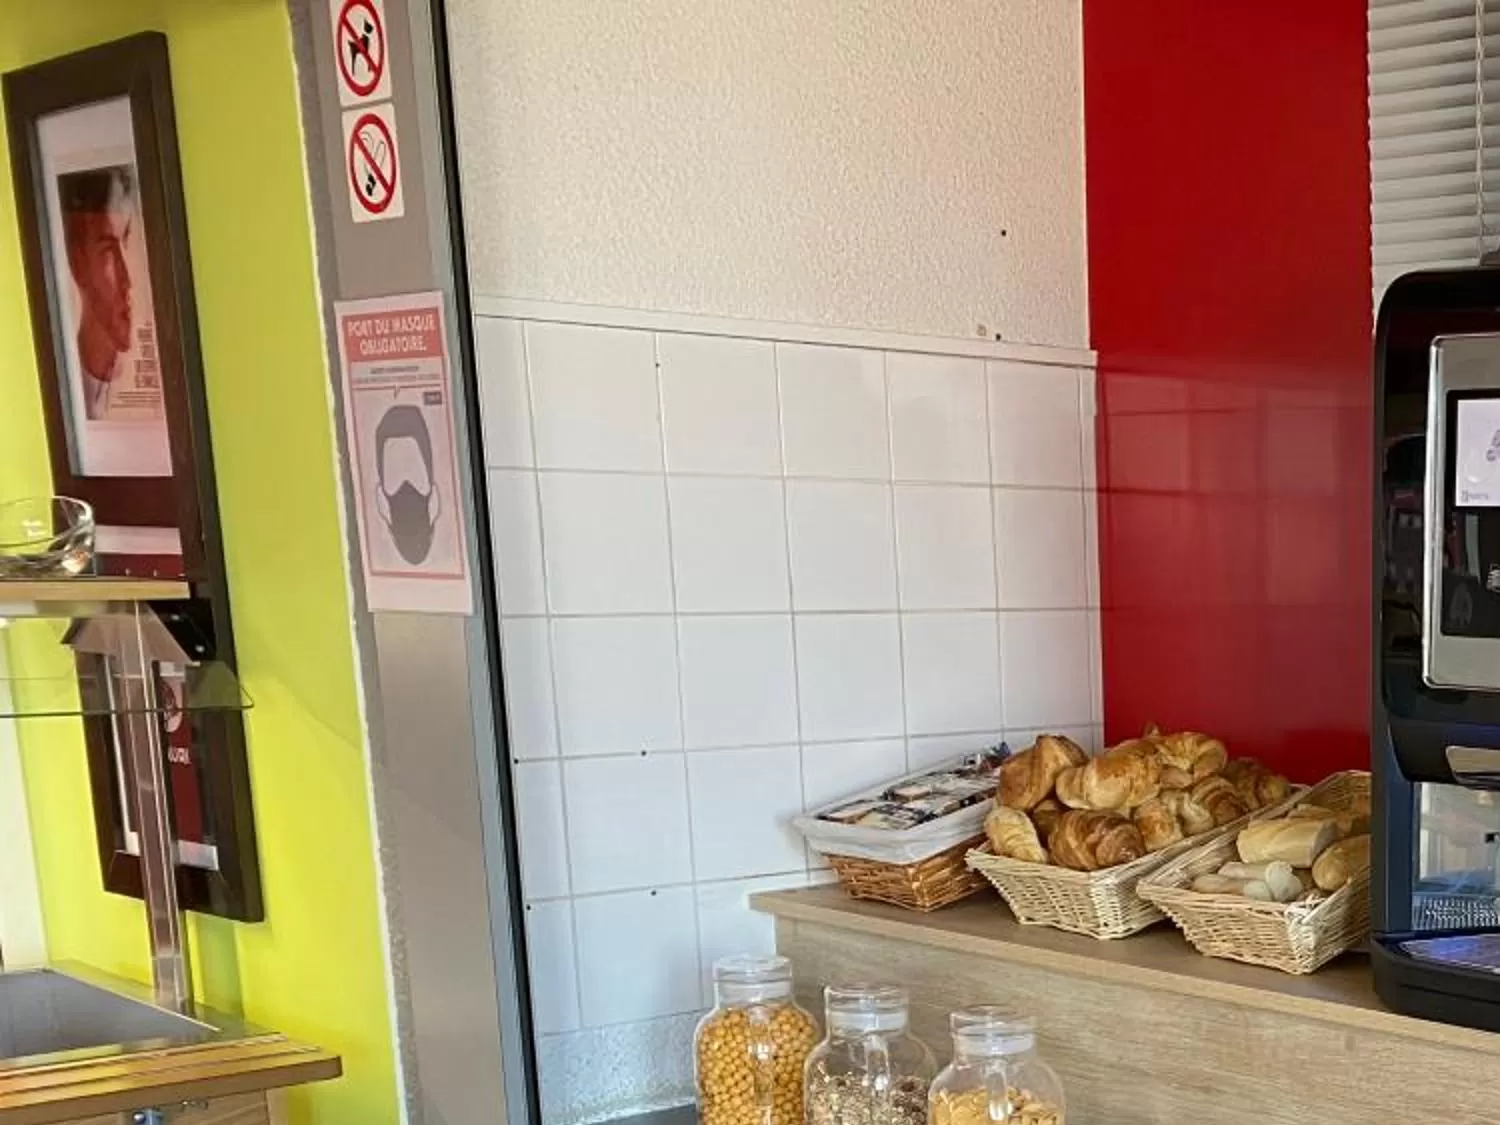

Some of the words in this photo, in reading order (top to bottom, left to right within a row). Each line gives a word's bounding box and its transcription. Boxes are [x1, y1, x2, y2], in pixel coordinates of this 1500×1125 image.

[347, 320, 373, 337] PORT
[375, 319, 389, 334] DU
[391, 314, 436, 332] MASQUE
